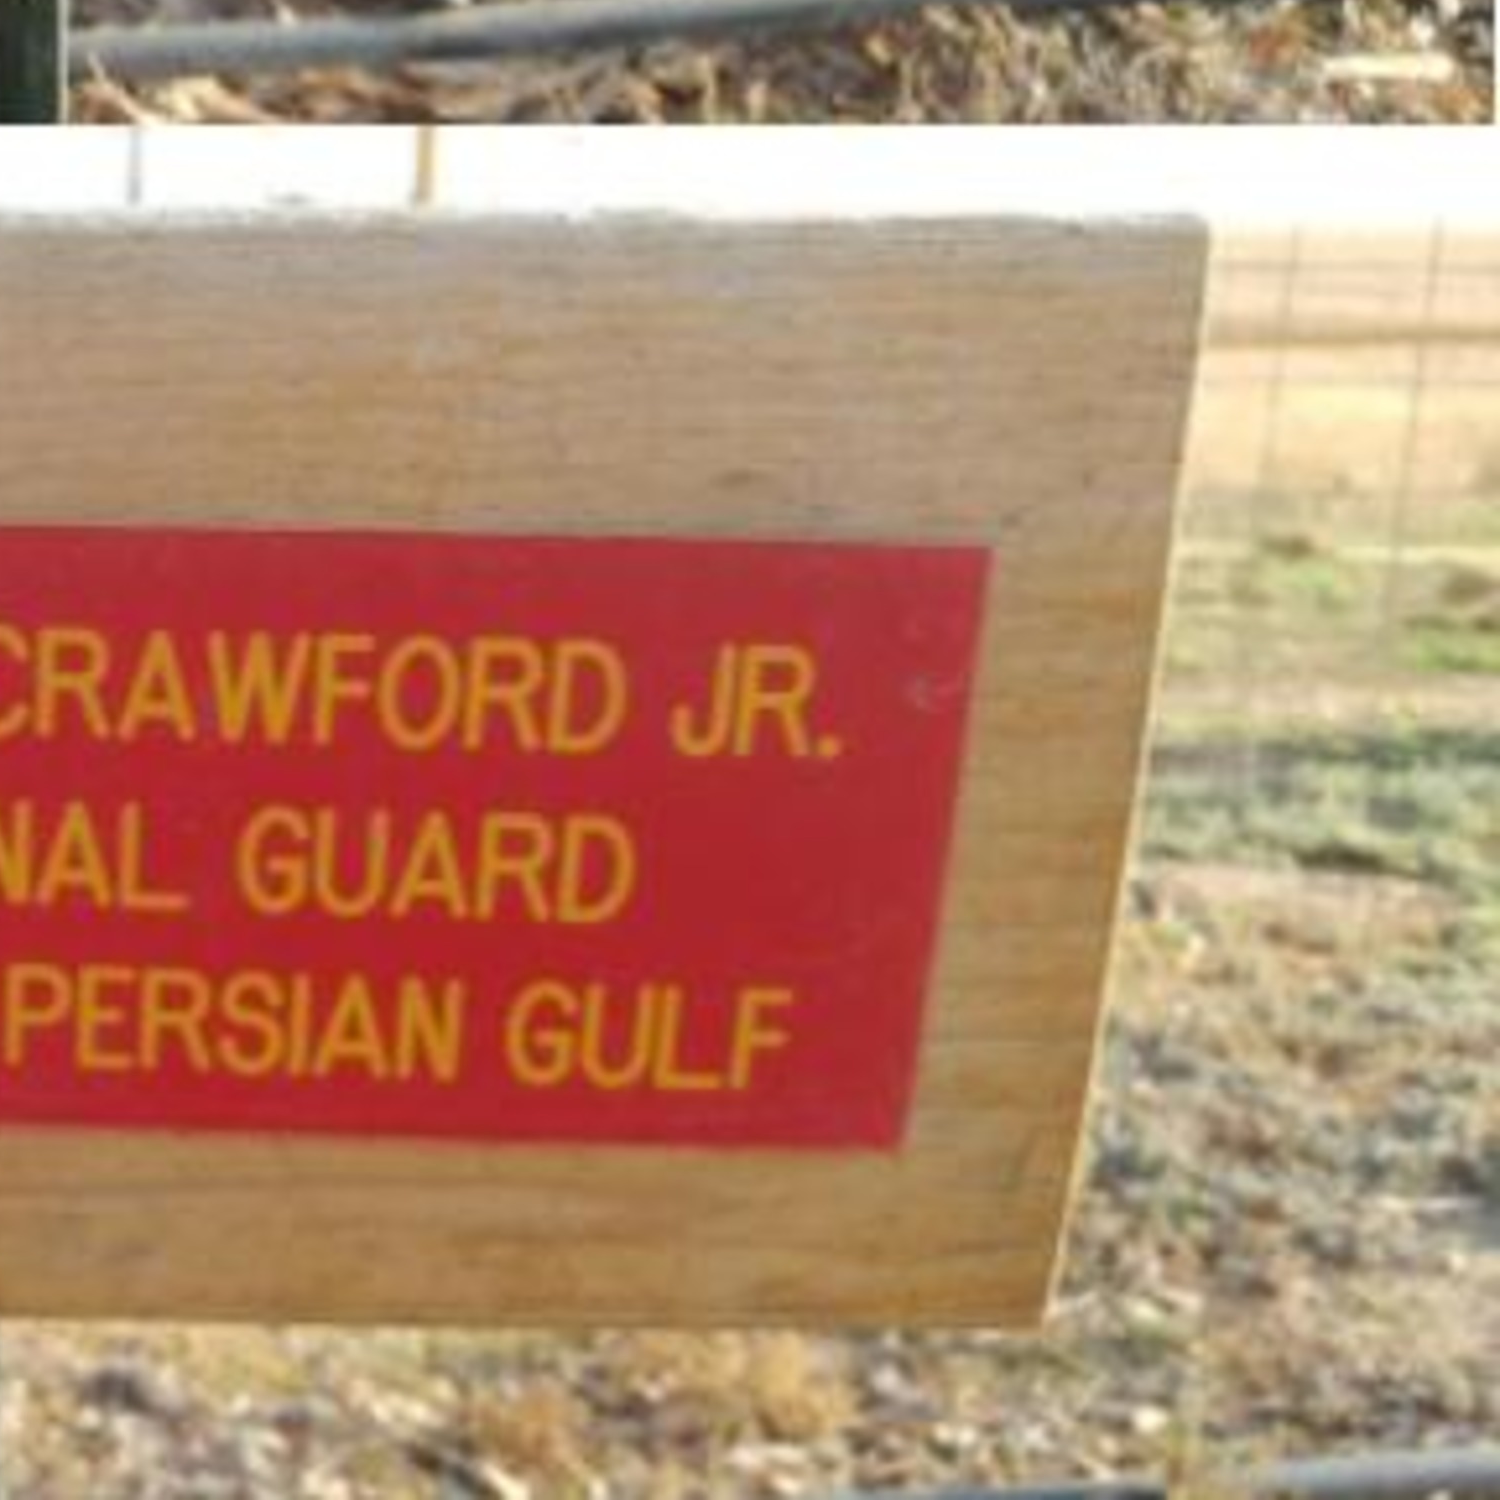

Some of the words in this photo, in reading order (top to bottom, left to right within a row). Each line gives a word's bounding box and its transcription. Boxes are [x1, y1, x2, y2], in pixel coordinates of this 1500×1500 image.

[669, 640, 843, 762] JR.
[235, 803, 638, 927] GUARD
[2, 959, 464, 1083] PERSIAN
[503, 978, 795, 1093] GULF
